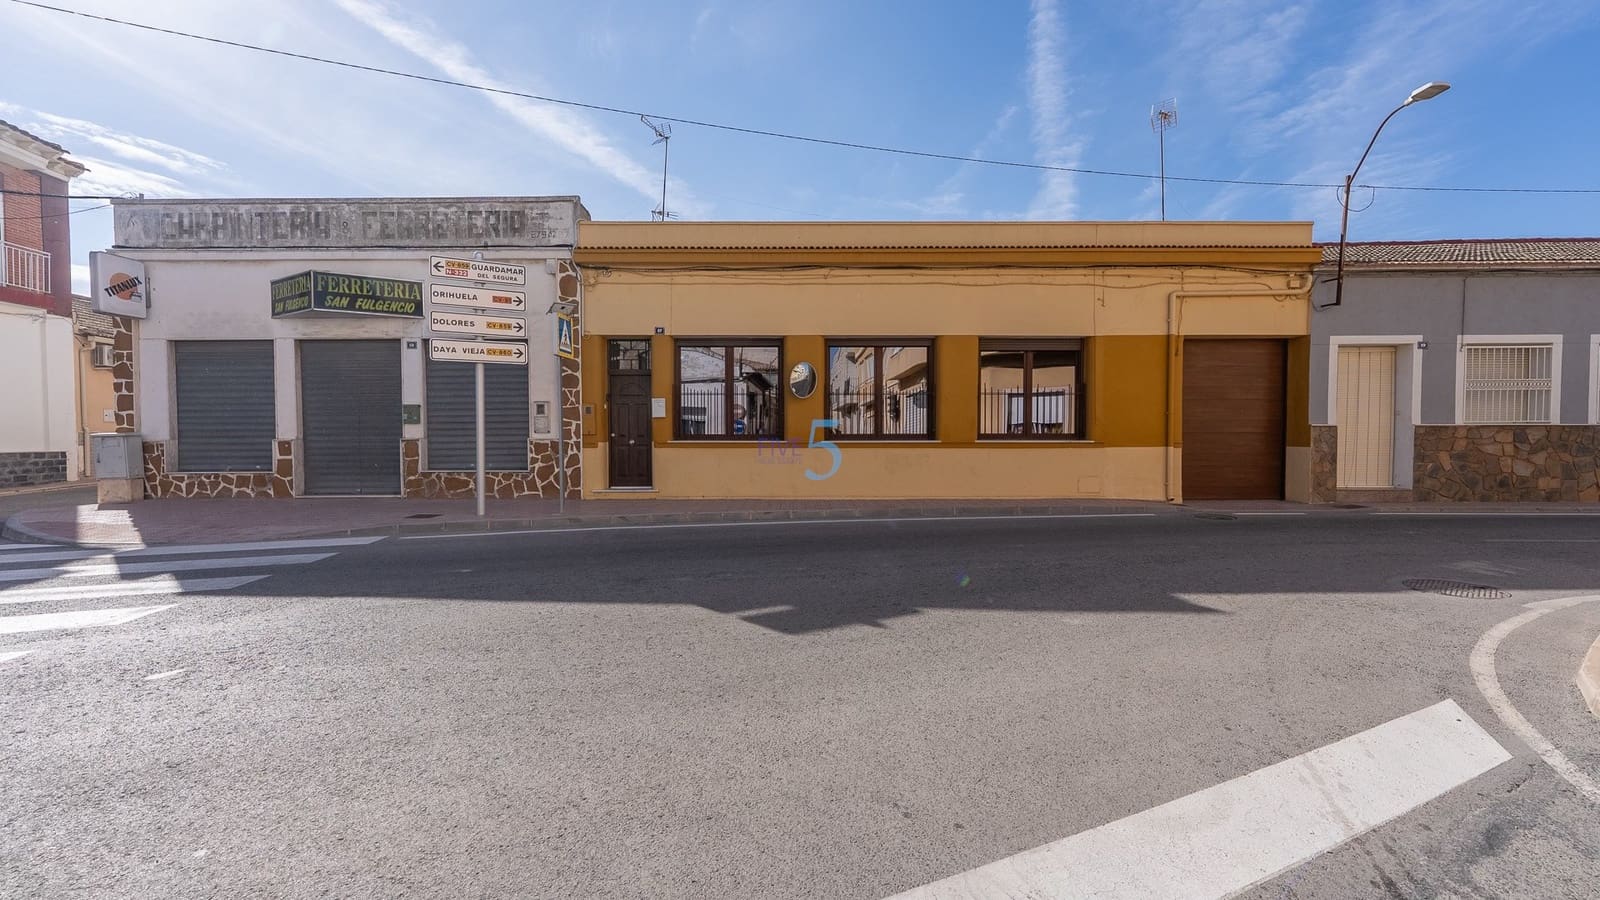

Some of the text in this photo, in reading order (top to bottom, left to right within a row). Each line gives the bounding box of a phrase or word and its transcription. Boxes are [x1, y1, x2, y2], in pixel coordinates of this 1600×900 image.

[471, 263, 524, 276] GUARDAMAR
[104, 276, 142, 297] TITANLUX
[272, 273, 312, 300] FERRETERIA
[316, 274, 421, 300] FERRETERIA
[433, 290, 478, 301] ORIHUELA
[325, 295, 416, 314] SAN FULGENCIO
[432, 318, 475, 327] DOLORES
[433, 345, 486, 355] DAYA VIEJA
